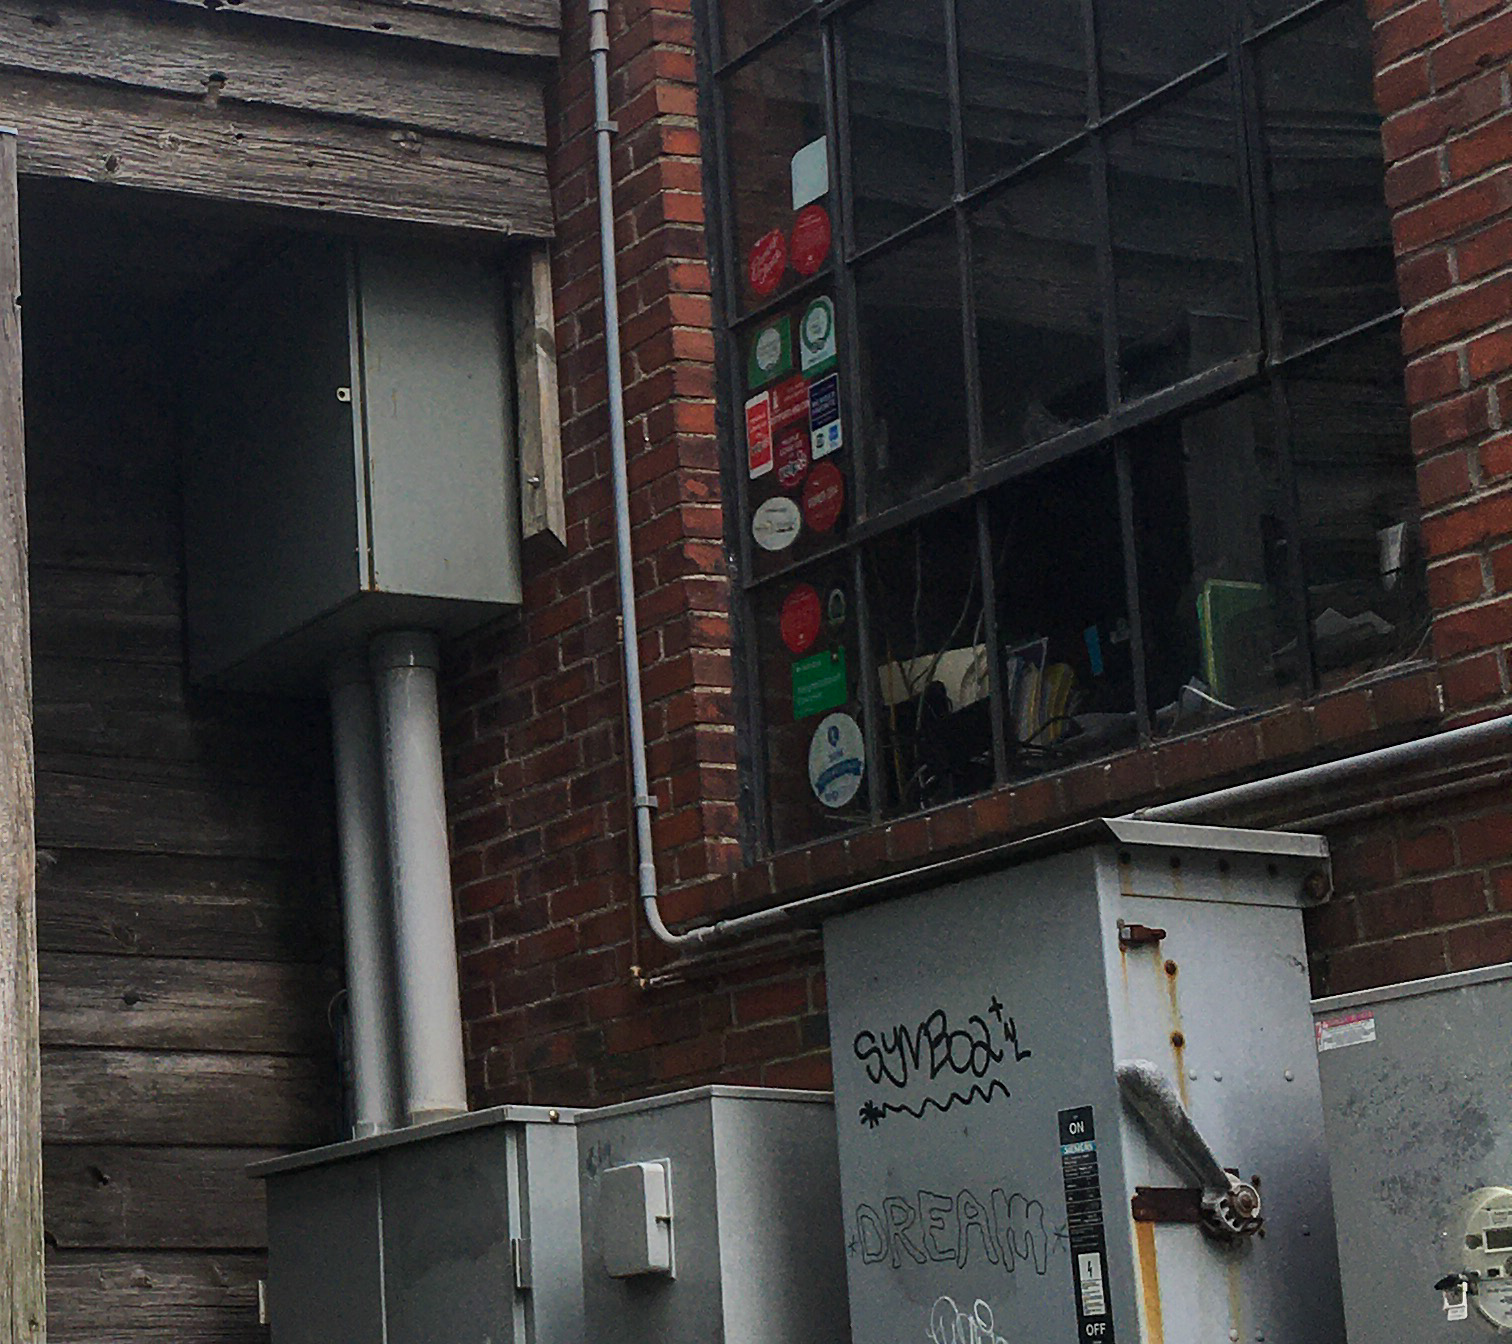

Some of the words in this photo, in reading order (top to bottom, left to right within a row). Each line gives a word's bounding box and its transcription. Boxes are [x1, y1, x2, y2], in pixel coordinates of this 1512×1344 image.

[1068, 1121, 1085, 1135] ON
[855, 1187, 1048, 1275] DREAM
[1085, 1323, 1106, 1336] OFF
